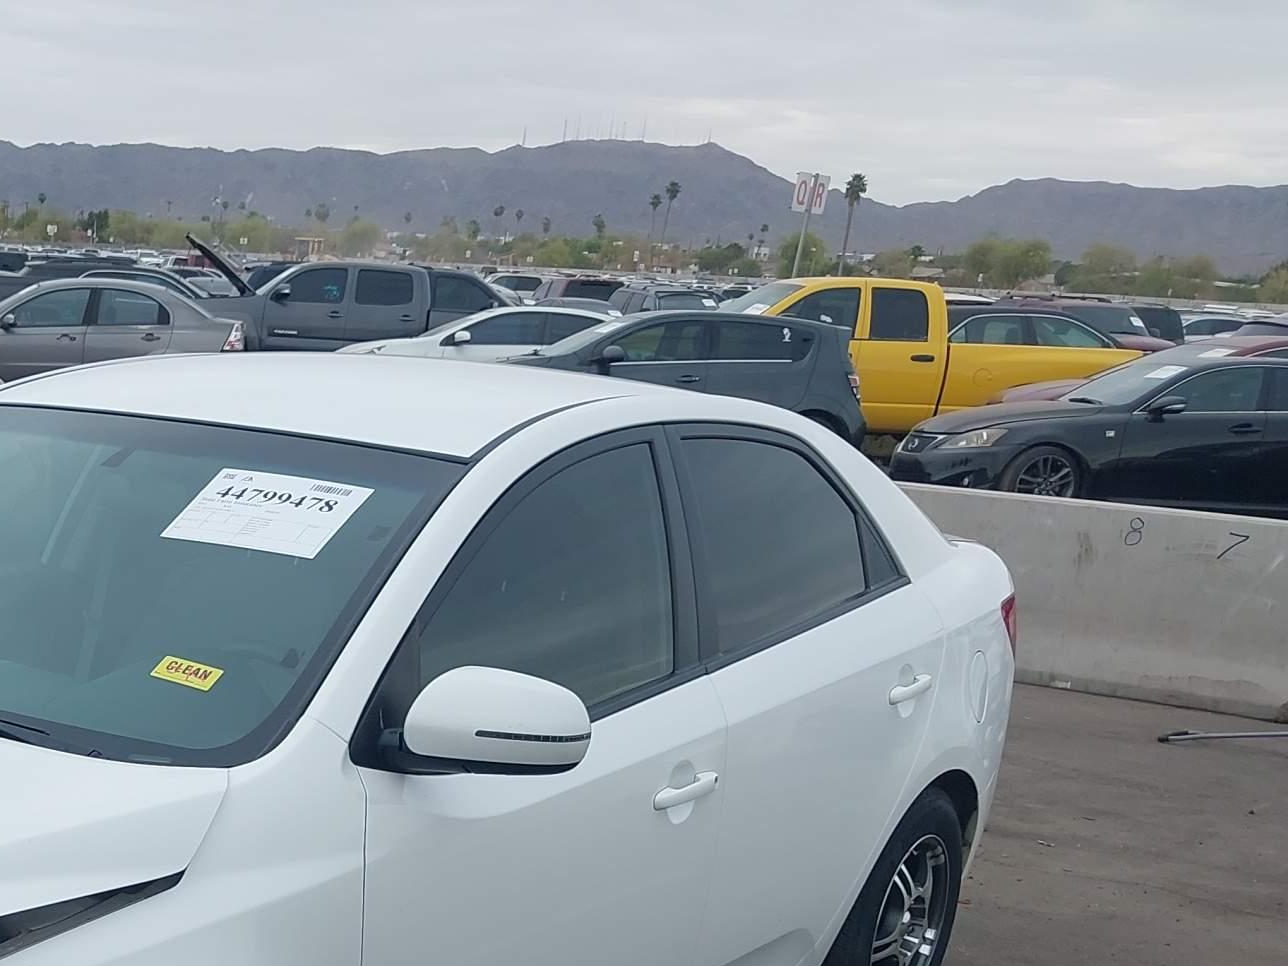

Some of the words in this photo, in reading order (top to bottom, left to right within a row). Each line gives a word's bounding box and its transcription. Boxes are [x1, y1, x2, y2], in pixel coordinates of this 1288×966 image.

[796, 179, 808, 206] Q
[813, 182, 825, 208] R
[216, 485, 339, 513] 44799478
[1124, 516, 1145, 546] 8
[1216, 531, 1250, 559] 7
[166, 660, 213, 681] CLEAN
